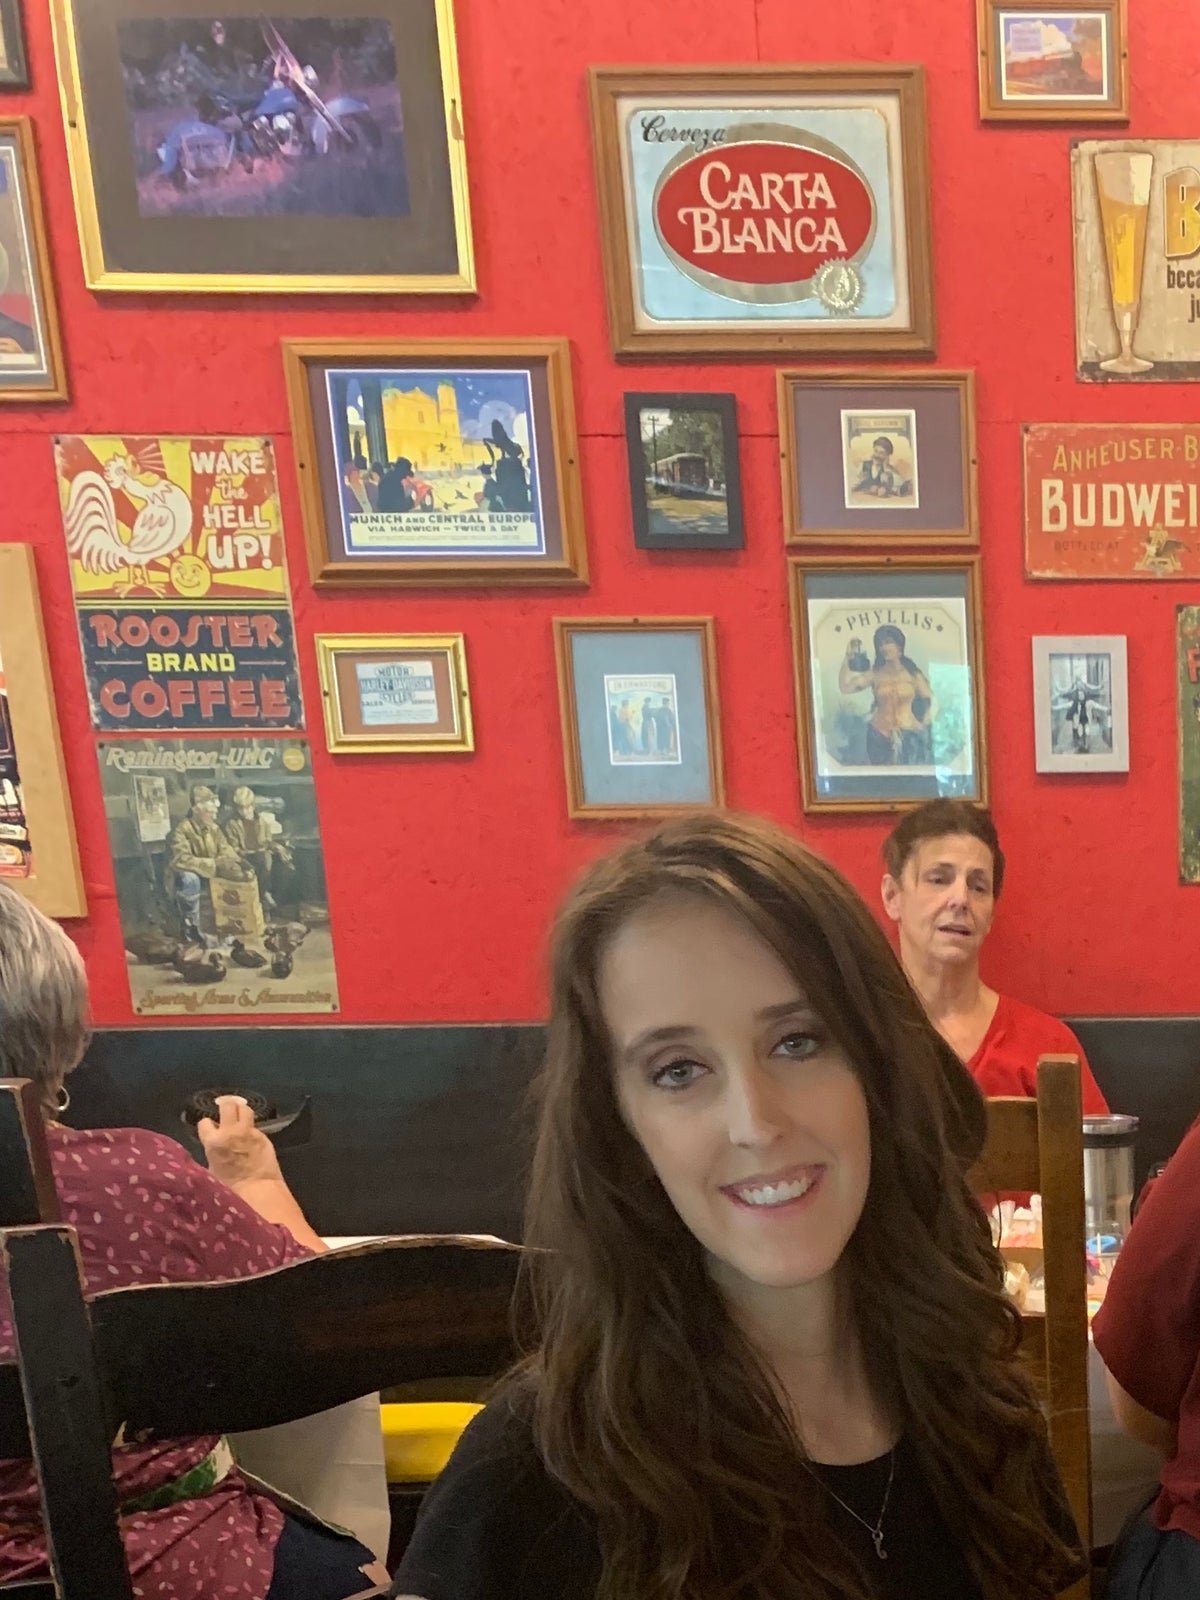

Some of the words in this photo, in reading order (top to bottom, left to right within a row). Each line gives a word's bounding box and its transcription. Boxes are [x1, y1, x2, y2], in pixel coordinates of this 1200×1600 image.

[641, 115, 726, 153] Cerveza
[699, 161, 836, 214] CARTA
[677, 207, 848, 253] BLANCA
[190, 451, 266, 474] WAKE
[216, 477, 248, 500] the
[203, 505, 270, 528] HELL
[350, 514, 402, 524] MUNICH
[428, 514, 484, 524] CENTRAL
[488, 514, 536, 524] EUROPE
[208, 535, 272, 569] UP!
[89, 614, 283, 647] ROOSTER
[846, 610, 933, 631] PHYLLIS
[146, 653, 235, 672] BRAND
[101, 679, 290, 718] COFFEE
